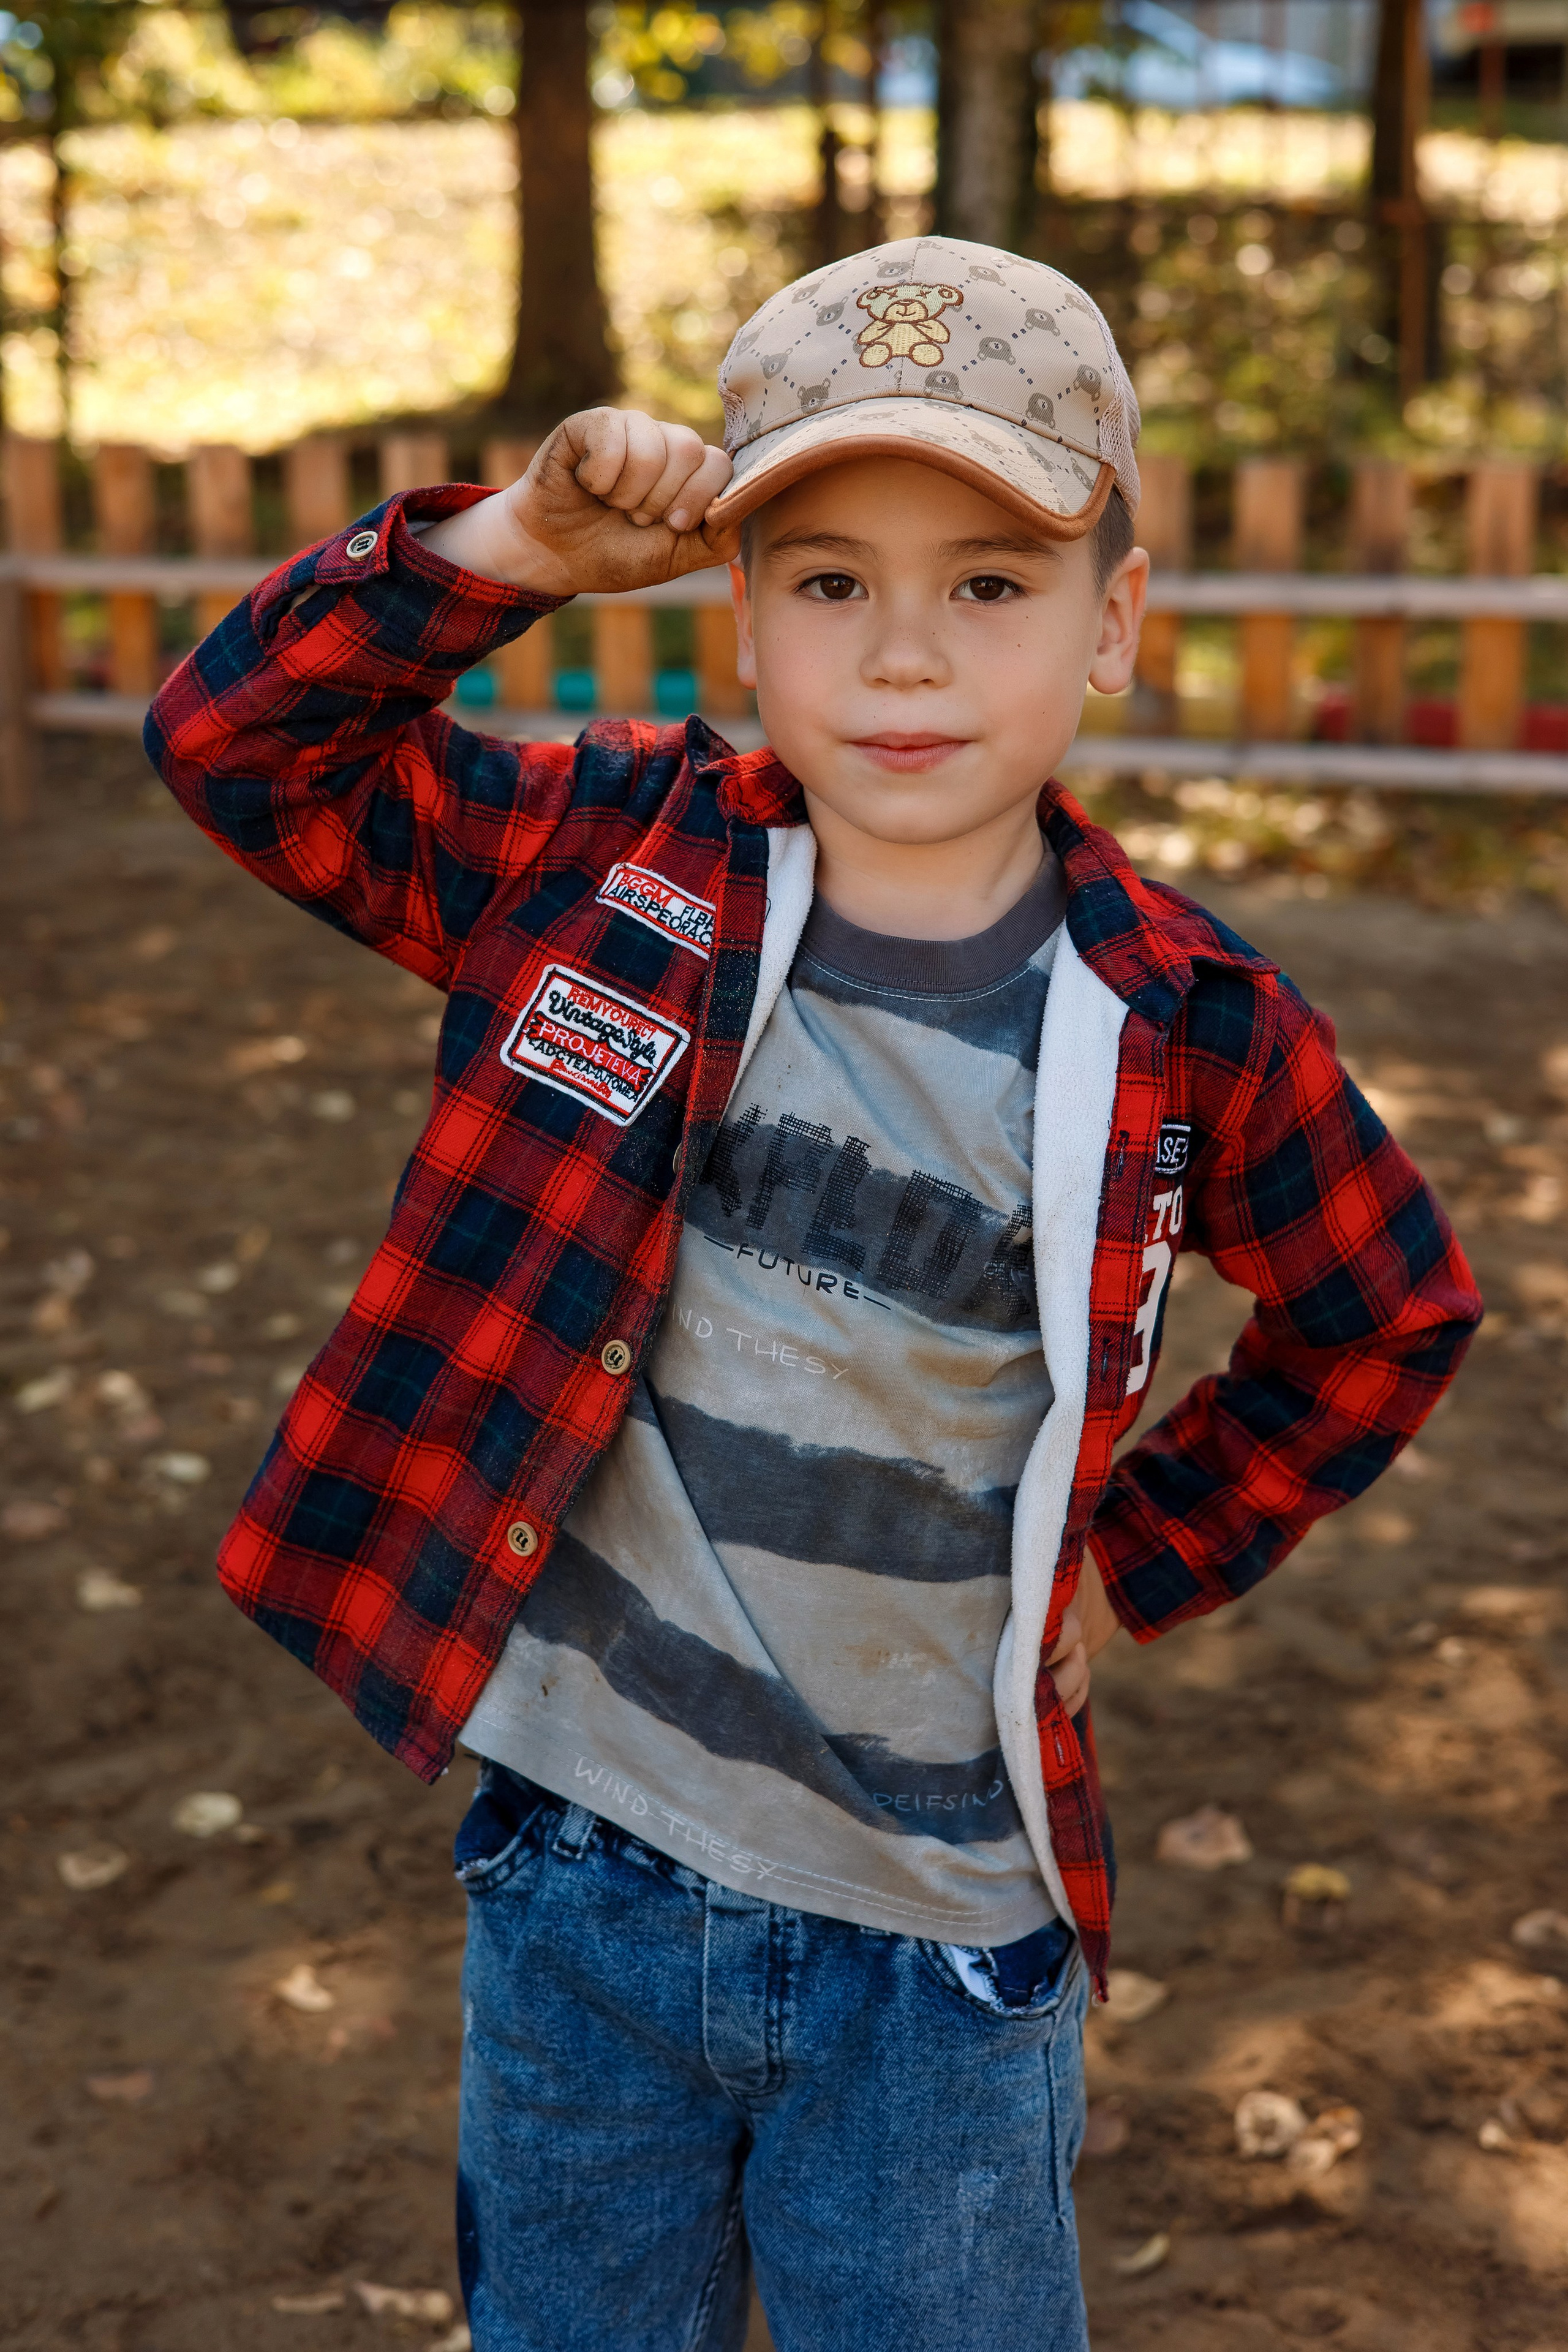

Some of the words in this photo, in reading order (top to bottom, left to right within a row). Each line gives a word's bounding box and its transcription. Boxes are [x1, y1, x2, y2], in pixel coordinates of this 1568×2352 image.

[736, 1244, 860, 1299] FUTURE
[726, 1327, 850, 1380] THESY
[575, 1755, 649, 1815] WIND
[660, 1810, 778, 1880] THESY
